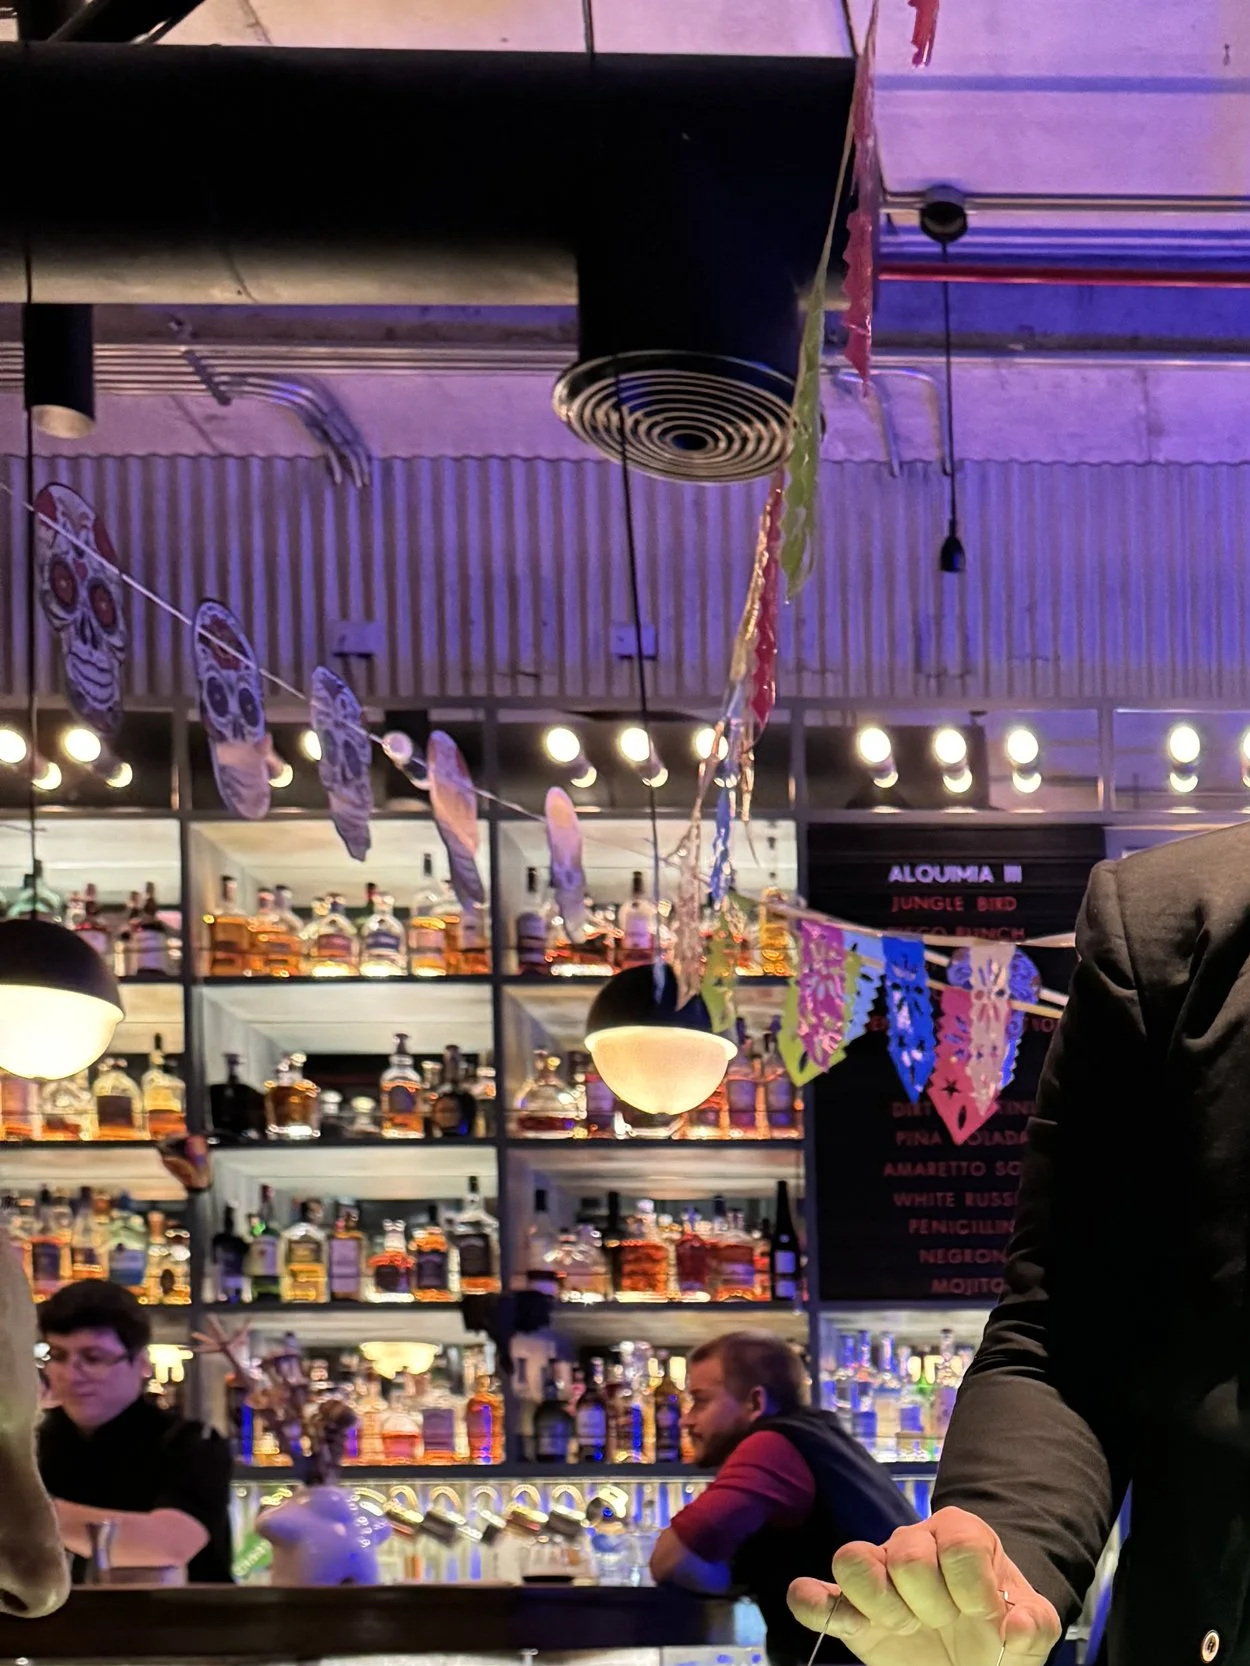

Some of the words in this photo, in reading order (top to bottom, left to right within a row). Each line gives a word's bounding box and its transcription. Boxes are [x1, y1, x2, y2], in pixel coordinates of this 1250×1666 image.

[888, 864, 995, 884] ALQUIMIA
[891, 897, 964, 912] JUNGLE
[977, 897, 1017, 912] BIRD
[891, 1102, 932, 1117] DIRT
[966, 1131, 1029, 1146] OLADA
[884, 1161, 986, 1177] AMARETTO
[995, 1161, 1022, 1176] SO
[893, 1192, 955, 1207] WHITE
[966, 1192, 1018, 1207] RUSSI
[908, 1219, 1015, 1234] PENICILLIN
[919, 1249, 1008, 1264] NEGRON
[931, 1278, 1004, 1295] MOJITO
